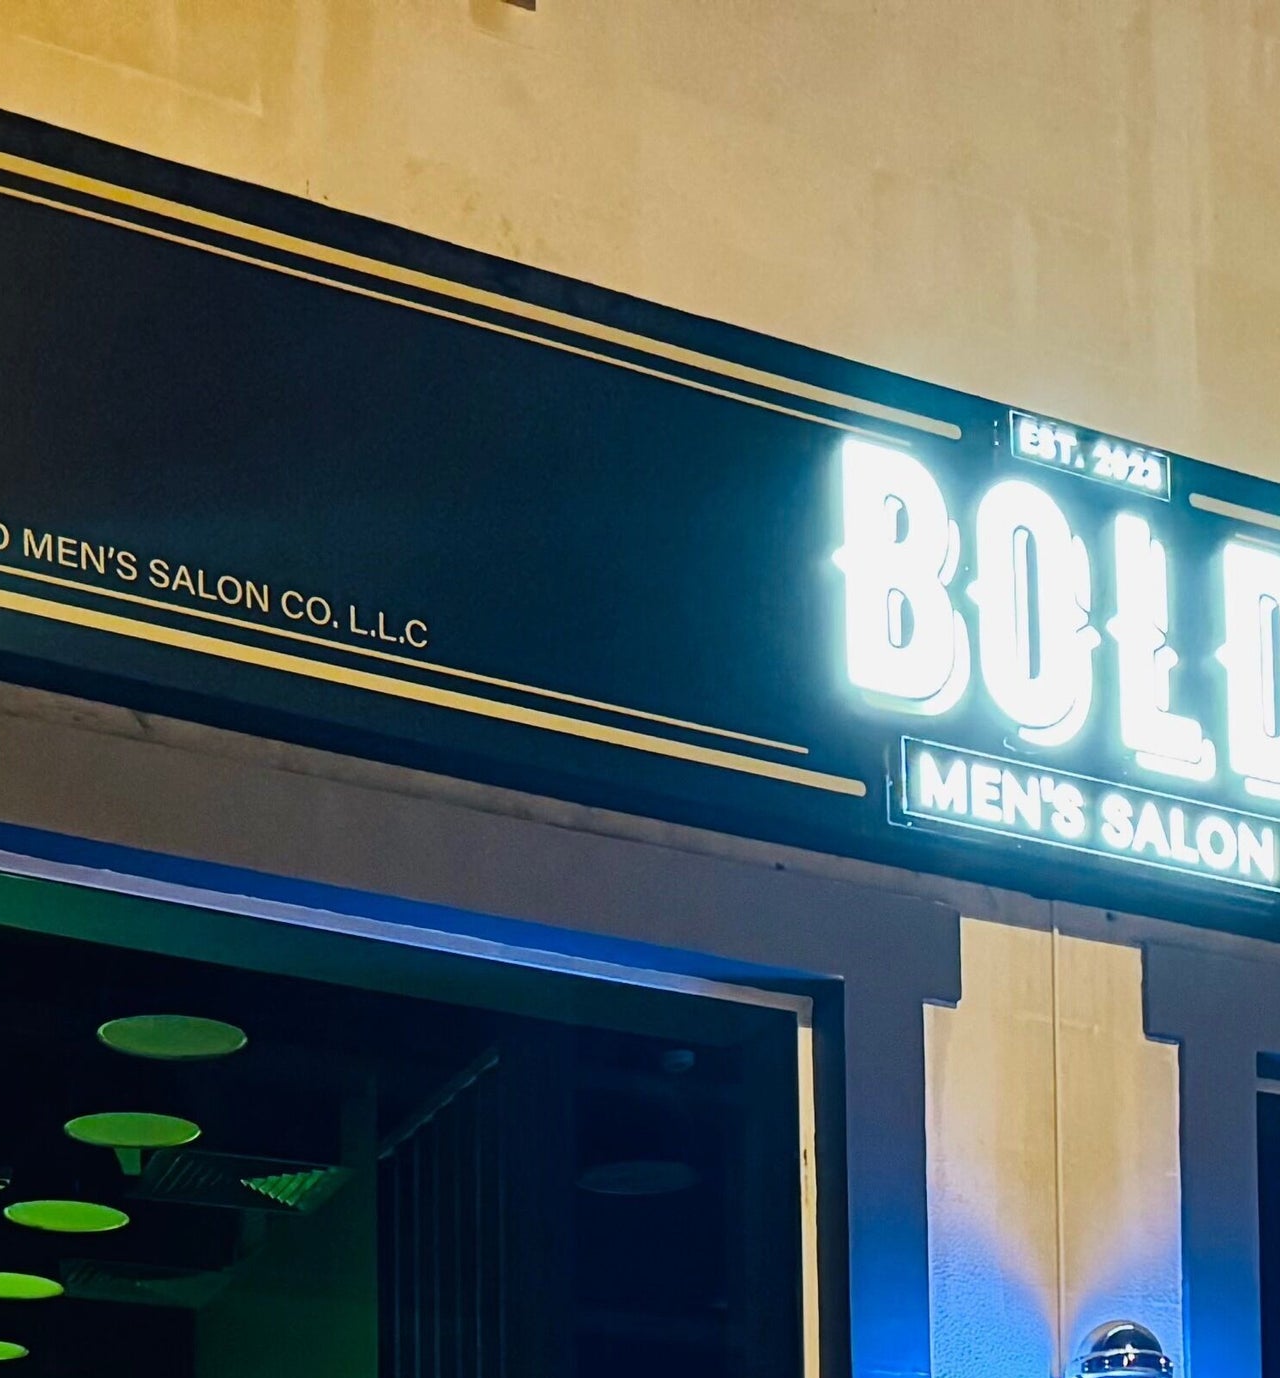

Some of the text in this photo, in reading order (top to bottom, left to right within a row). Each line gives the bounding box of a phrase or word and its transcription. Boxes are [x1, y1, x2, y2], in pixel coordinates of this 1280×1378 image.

[1020, 419, 1085, 469] EST.
[23, 527, 138, 581] MEN'S
[149, 558, 270, 613] SALON
[281, 590, 339, 629] CO.
[350, 604, 428, 648] L.L.C
[918, 751, 1275, 881] MEN'S SALON
